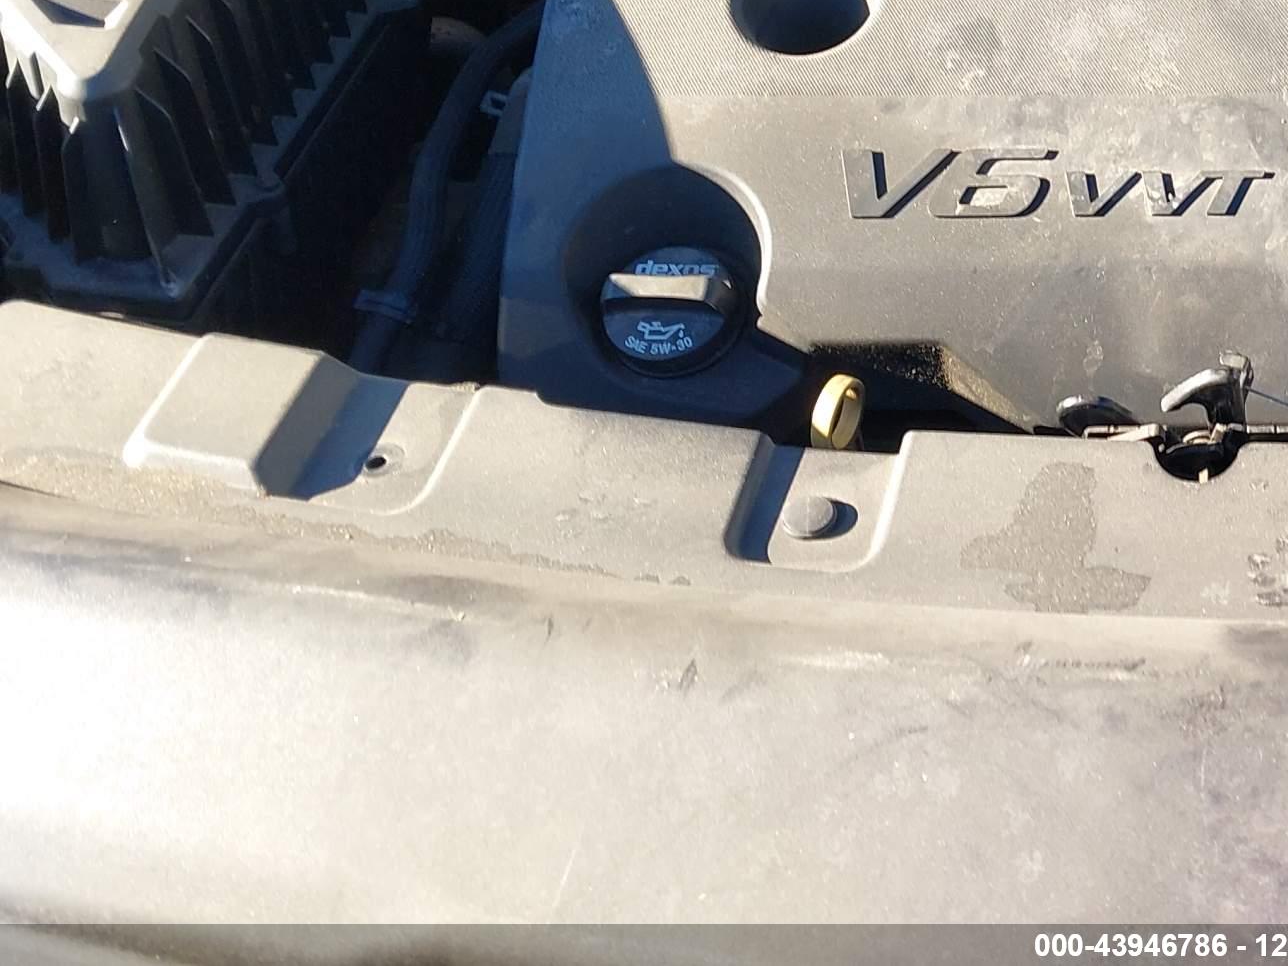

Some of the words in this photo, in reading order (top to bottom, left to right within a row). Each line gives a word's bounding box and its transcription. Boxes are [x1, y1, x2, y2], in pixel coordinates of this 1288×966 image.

[841, 149, 1059, 219] V6
[1065, 170, 1276, 218] VVT
[634, 260, 716, 277] dexos
[624, 335, 646, 354] SAE
[649, 336, 694, 355] 5W-30
